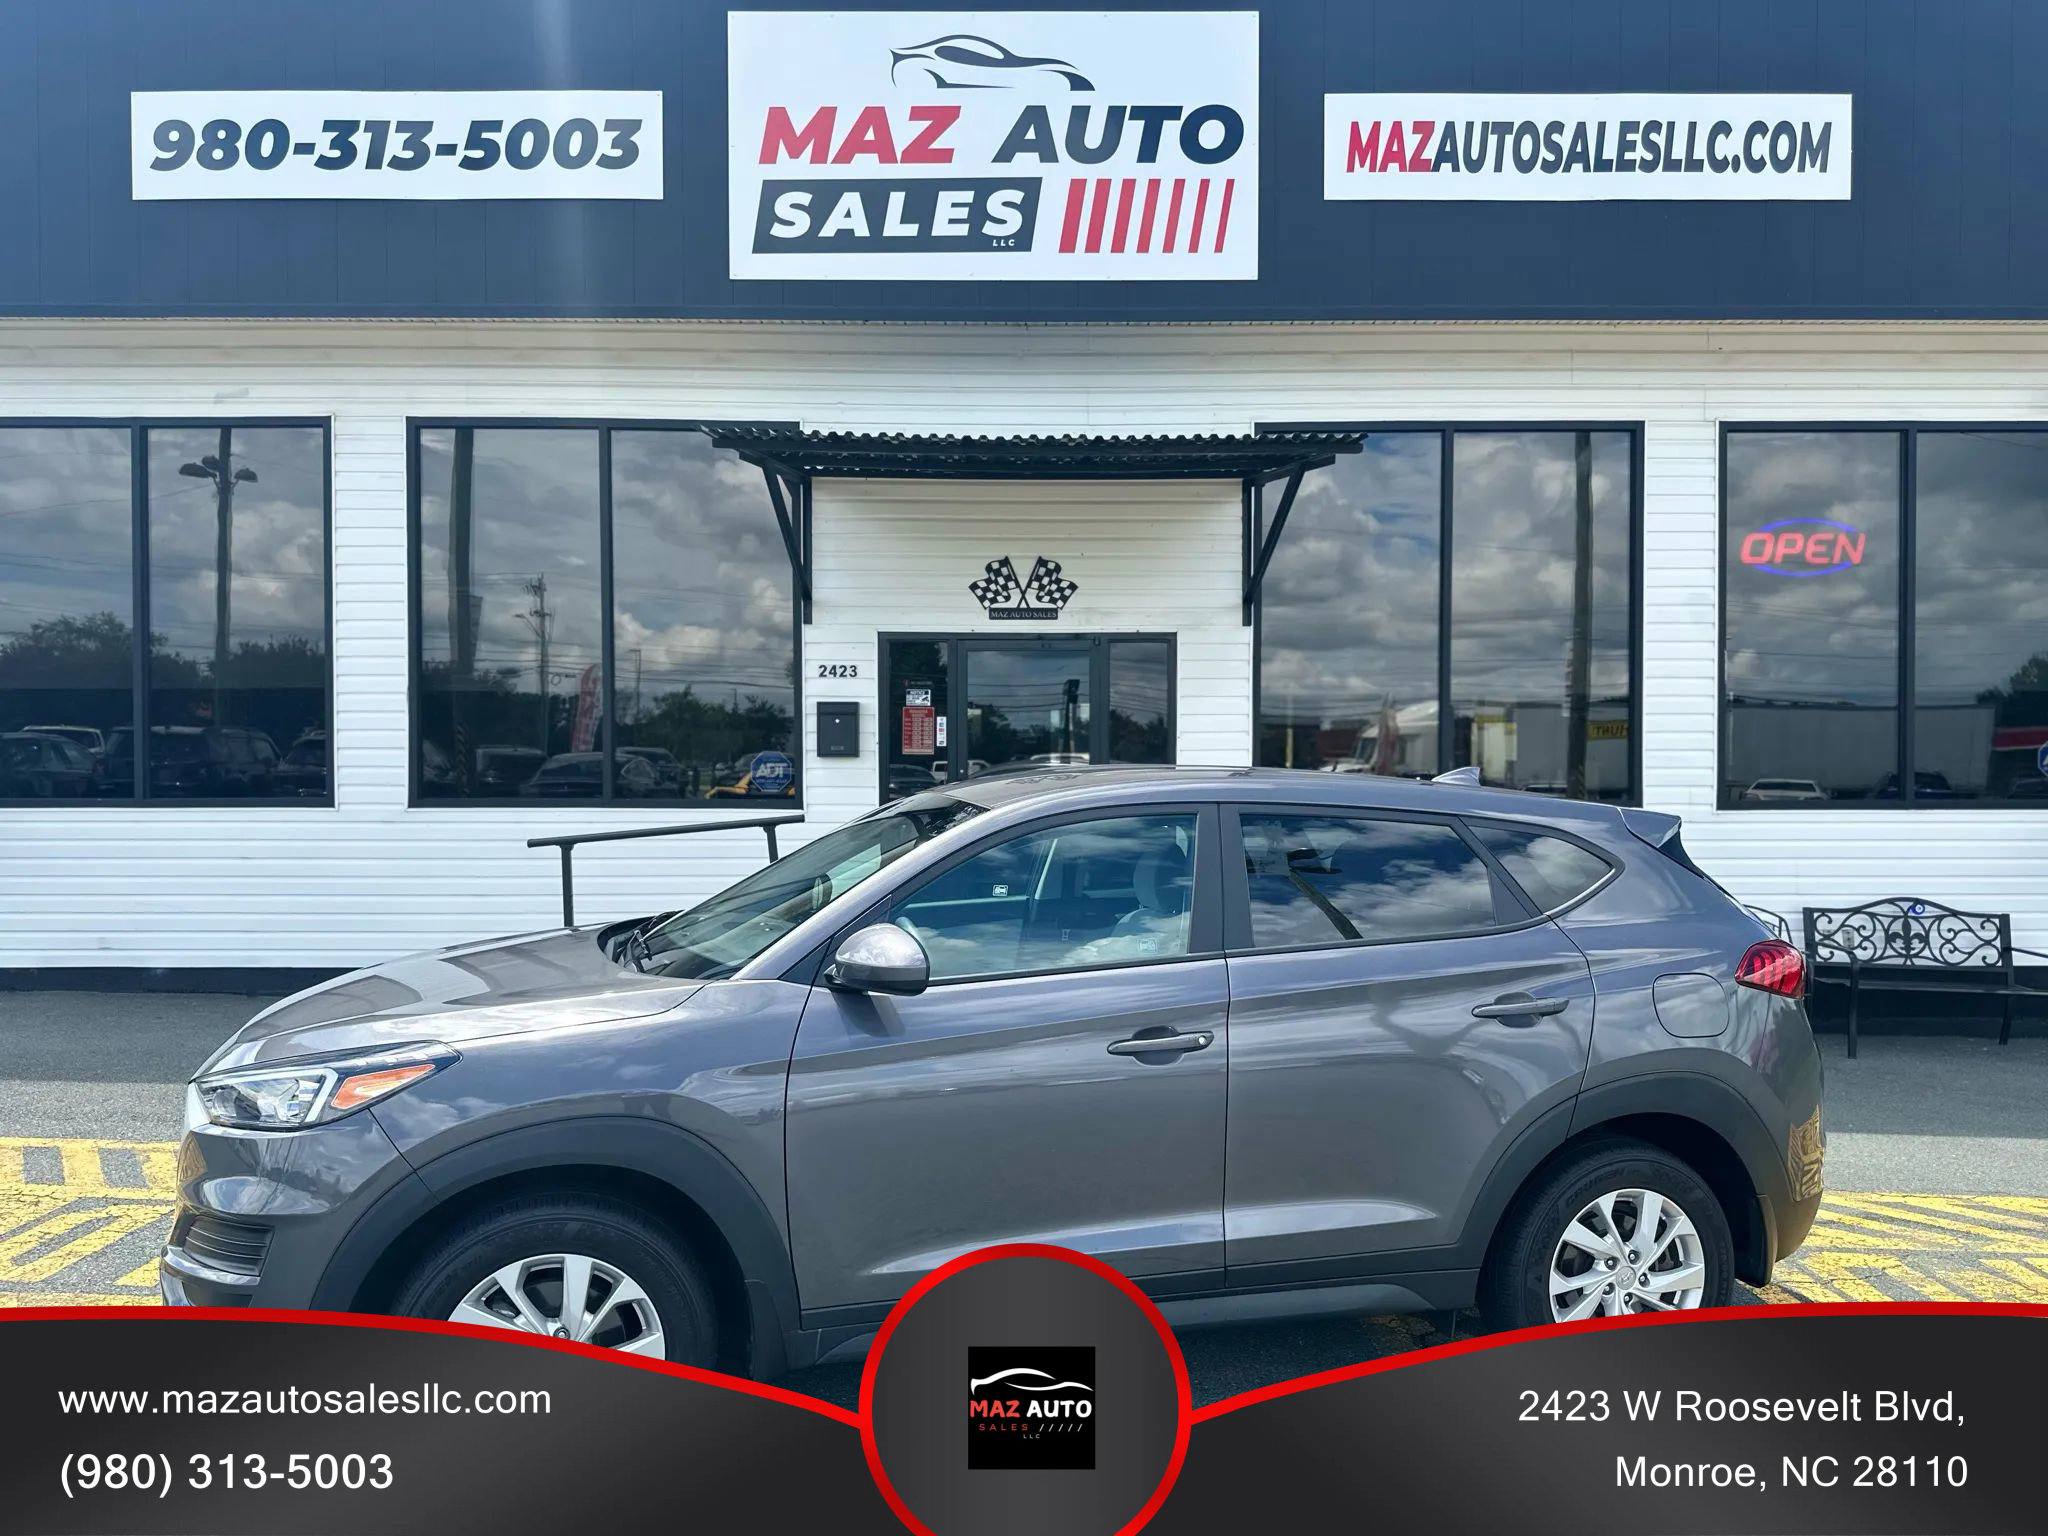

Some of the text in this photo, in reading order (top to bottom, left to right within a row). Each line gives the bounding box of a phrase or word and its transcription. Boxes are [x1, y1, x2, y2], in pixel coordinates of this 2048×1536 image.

[149, 117, 643, 171] 980-313-5003
[758, 104, 1244, 165] MAZ AUTO
[1346, 120, 1832, 174] MAZAUTOSALESLLC.COM
[769, 189, 1025, 239] SALES
[992, 239, 1016, 247] LLC
[1740, 532, 1866, 564] OPEN
[990, 610, 1057, 618] MAZ AUTO SALES
[818, 665, 857, 678] 2423
[755, 763, 788, 778] ADT
